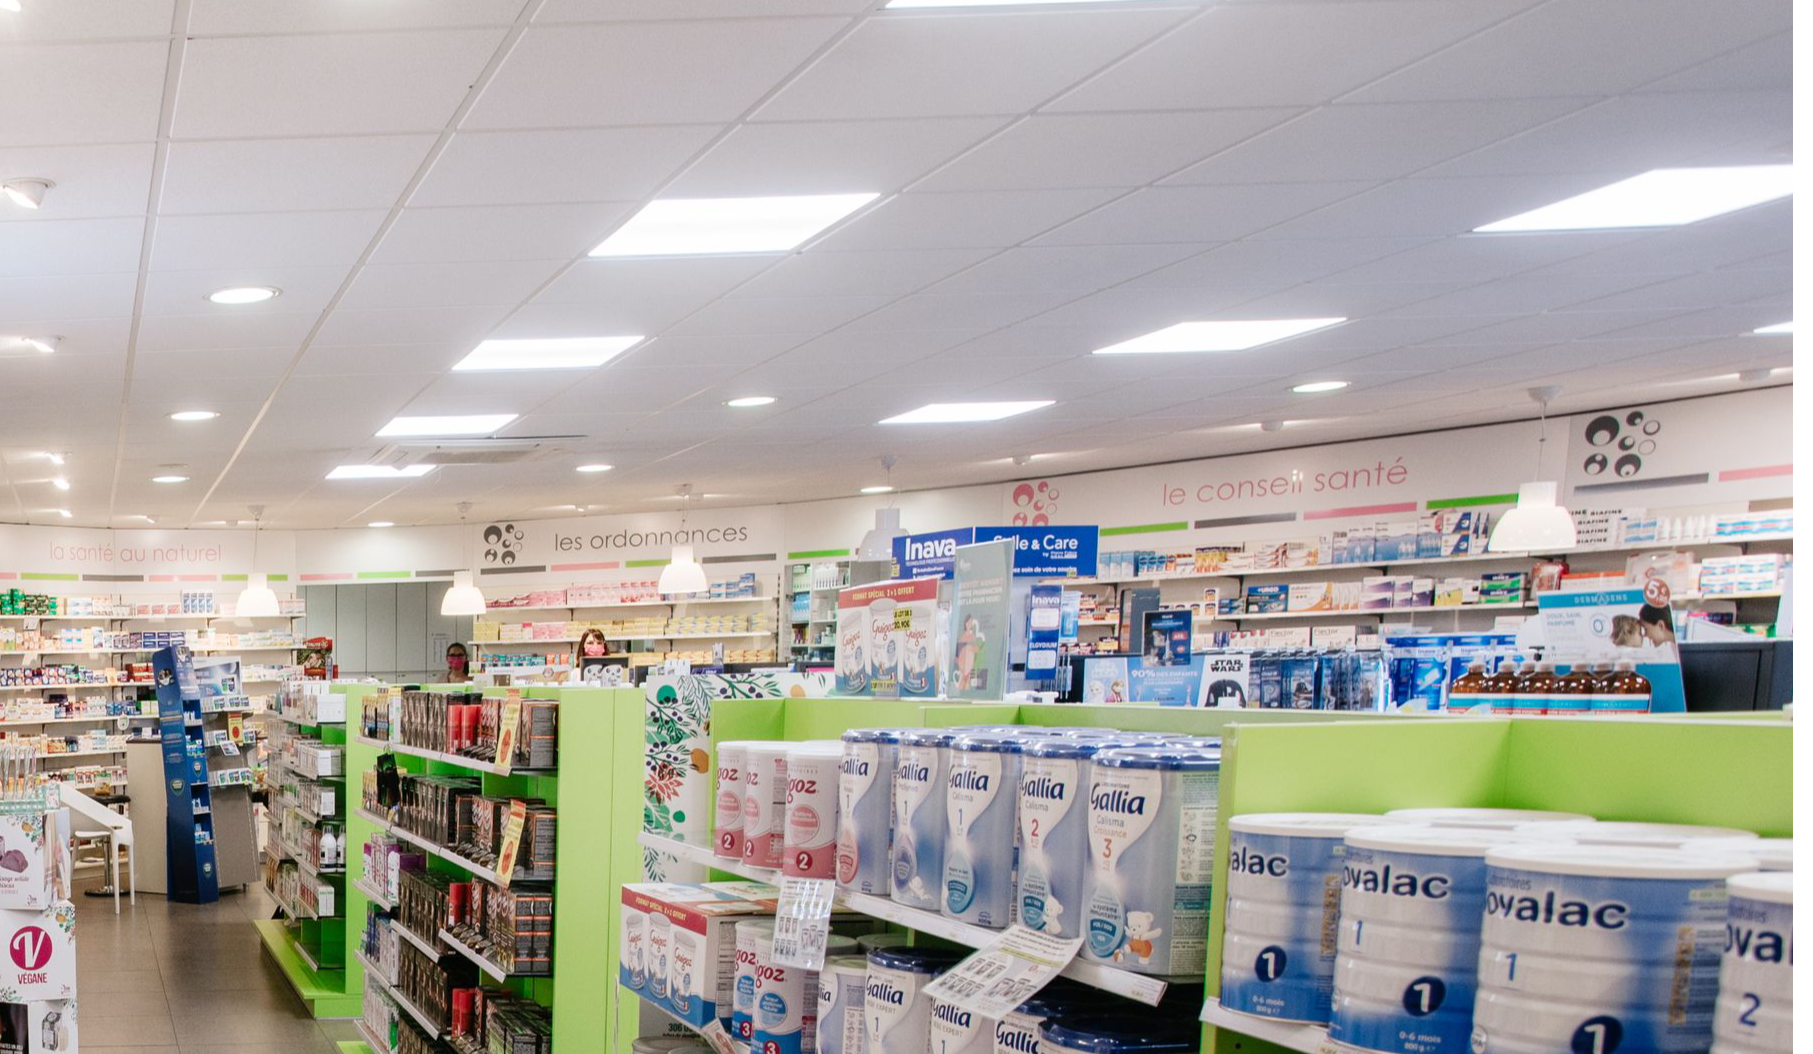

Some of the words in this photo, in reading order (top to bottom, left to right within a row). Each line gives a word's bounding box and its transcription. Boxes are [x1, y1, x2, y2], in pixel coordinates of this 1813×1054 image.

[1162, 481, 1186, 507] le
[1197, 469, 1302, 499] conseil
[1314, 457, 1408, 493] santé
[555, 533, 583, 552] les
[590, 525, 748, 550] ordonnances
[905, 538, 956, 561] Inava
[1043, 535, 1078, 550] Care
[50, 542, 64, 561] la
[69, 542, 113, 562] santé
[121, 548, 146, 562] au
[154, 544, 221, 562] naturel
[1214, 659, 1242, 667] STAR
[1021, 772, 1064, 799] Gallia
[1091, 782, 1145, 815] Gallia
[18, 971, 47, 985] VÉGANE
